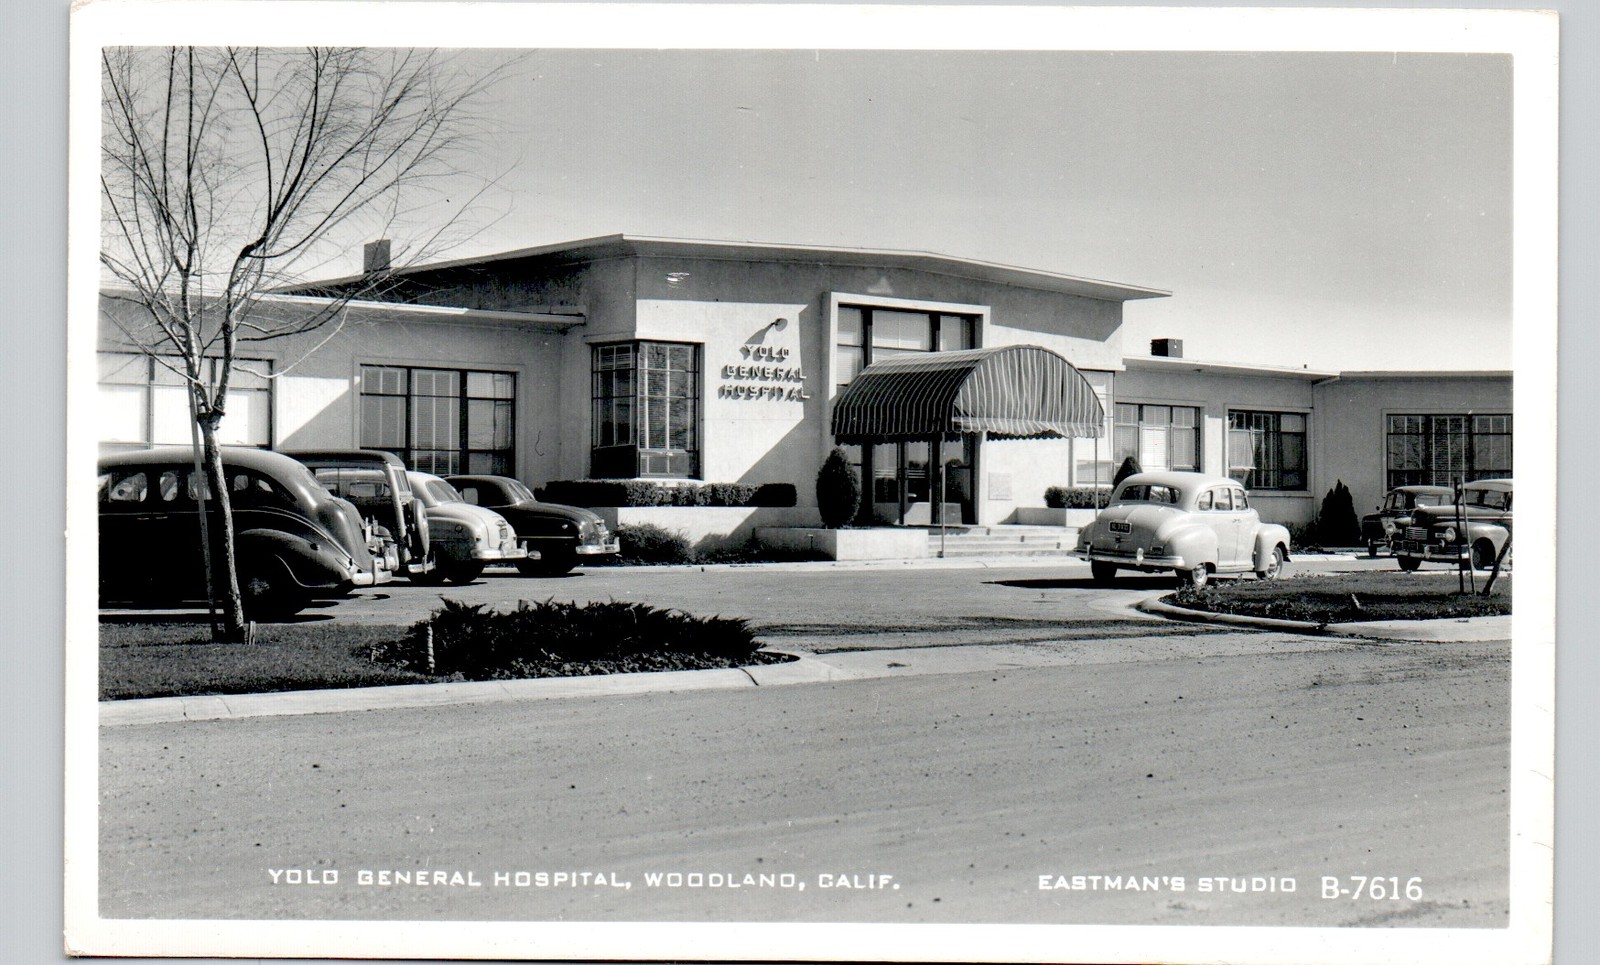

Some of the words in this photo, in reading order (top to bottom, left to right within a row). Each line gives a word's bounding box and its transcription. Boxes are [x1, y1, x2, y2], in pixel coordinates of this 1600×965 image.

[742, 344, 790, 360] YOLO
[723, 365, 807, 380] GENERAL
[720, 385, 811, 400] HOSPITAL
